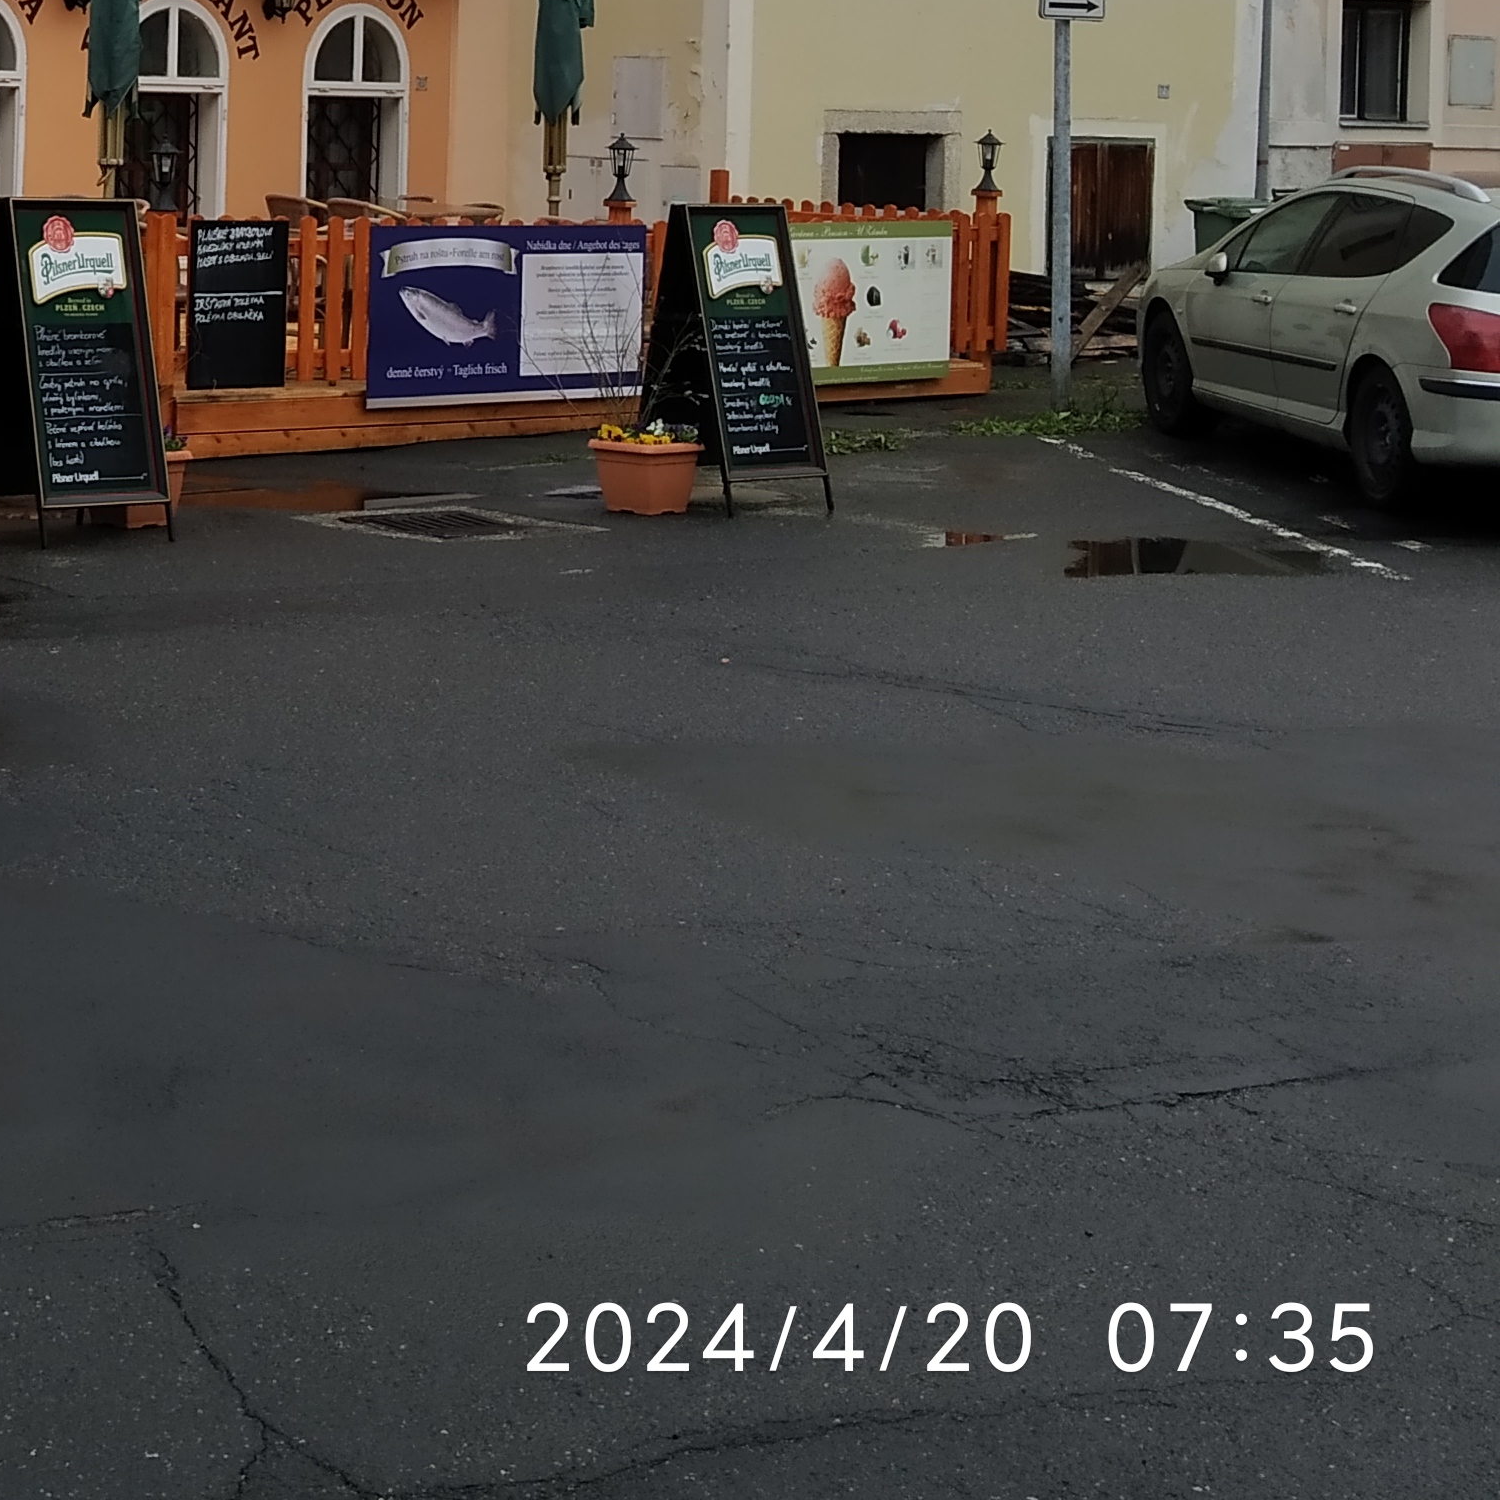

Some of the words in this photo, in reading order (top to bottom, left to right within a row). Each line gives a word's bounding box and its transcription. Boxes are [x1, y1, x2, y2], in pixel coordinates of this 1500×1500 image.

[558, 240, 572, 250] dne
[609, 240, 621, 250] des
[394, 251, 419, 265] Pstruh
[420, 252, 429, 260] na
[479, 250, 489, 259] am
[41, 253, 77, 286] Pilsner
[75, 252, 114, 275] Urquell
[713, 253, 741, 282] Pilsner
[740, 252, 771, 273] Urquell
[82, 303, 105, 311] CZECH
[485, 362, 508, 375] frisch
[52, 474, 75, 483] Pilsner
[74, 471, 99, 483] Urquell
